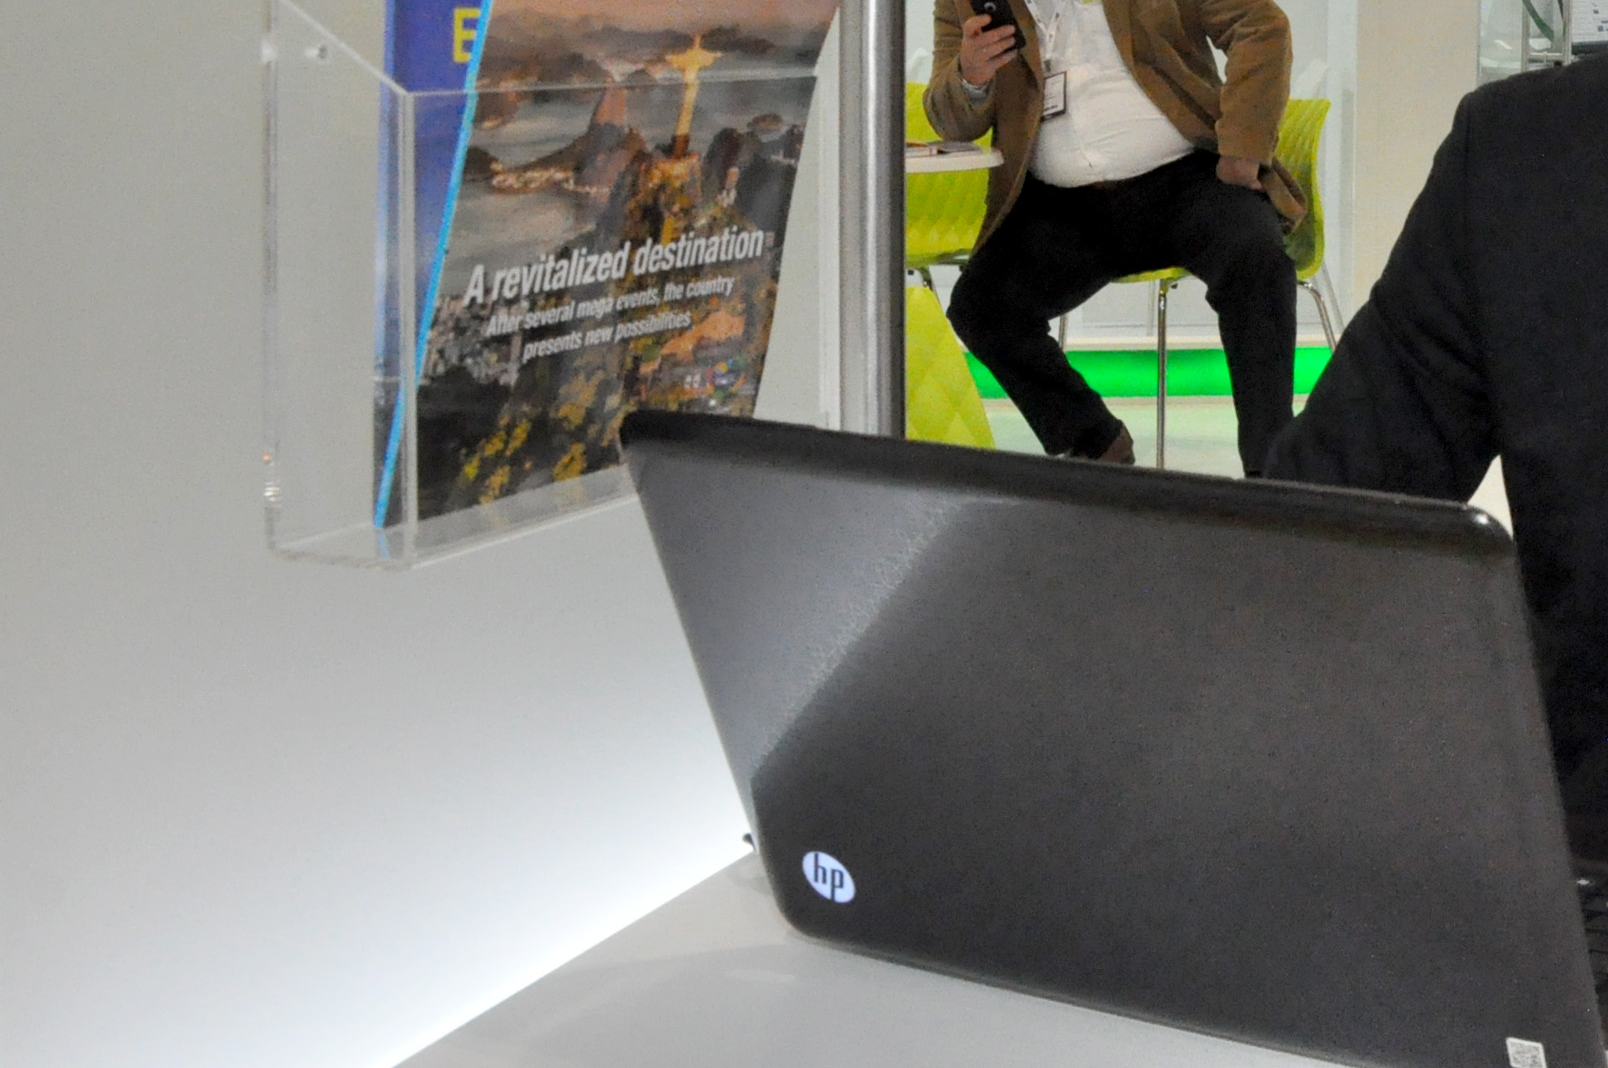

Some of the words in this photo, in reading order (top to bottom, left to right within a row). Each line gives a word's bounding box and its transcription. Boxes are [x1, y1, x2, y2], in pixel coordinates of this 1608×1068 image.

[461, 264, 485, 308] A
[490, 239, 632, 302] revitalized
[633, 225, 765, 277] destination
[485, 313, 524, 337] After
[524, 302, 575, 331] several
[577, 296, 613, 322] mega
[615, 288, 661, 311] events,
[664, 281, 683, 301] the
[686, 274, 736, 298] country
[521, 331, 583, 364] presents
[584, 325, 613, 347] new
[615, 310, 692, 345] possibilities
[814, 852, 845, 901] hp
